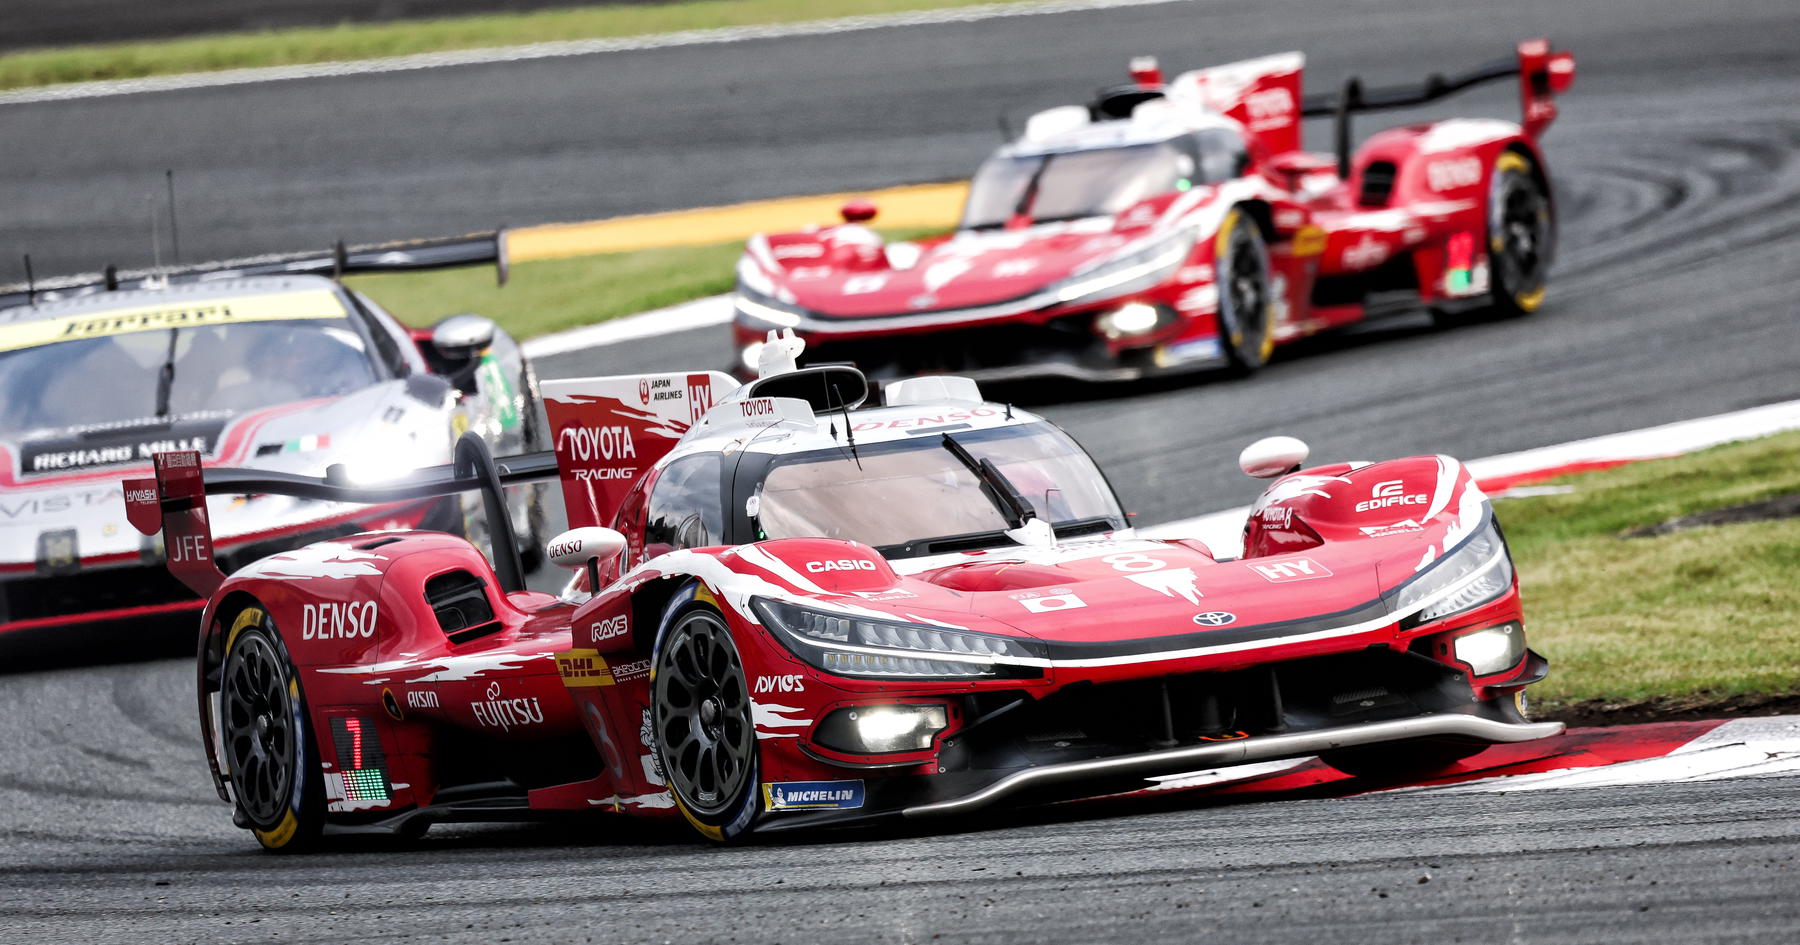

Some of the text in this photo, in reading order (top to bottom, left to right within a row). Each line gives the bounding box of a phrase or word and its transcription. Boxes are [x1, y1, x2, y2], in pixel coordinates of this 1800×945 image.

[651, 379, 671, 388] JAPAN
[653, 390, 683, 400] AIRLINES
[689, 384, 711, 425] HY
[739, 399, 775, 417] TOYOTA
[852, 409, 997, 432] DENSO
[568, 426, 637, 461] TOYOTA
[570, 467, 638, 481] RACING
[126, 489, 157, 502] HAYASHI
[1355, 494, 1428, 513] EDIFICE
[1284, 506, 1292, 529] 8
[173, 535, 208, 562] JFE
[549, 540, 582, 558] DENSO
[805, 559, 877, 573] CASIO
[1101, 553, 1167, 572] 8
[1256, 559, 1316, 579] HY
[302, 600, 377, 641] DENSO
[591, 614, 628, 642] RAYS
[559, 659, 602, 678] DHL
[470, 697, 545, 733] FUJITSU
[787, 789, 854, 802] MICHELIN
